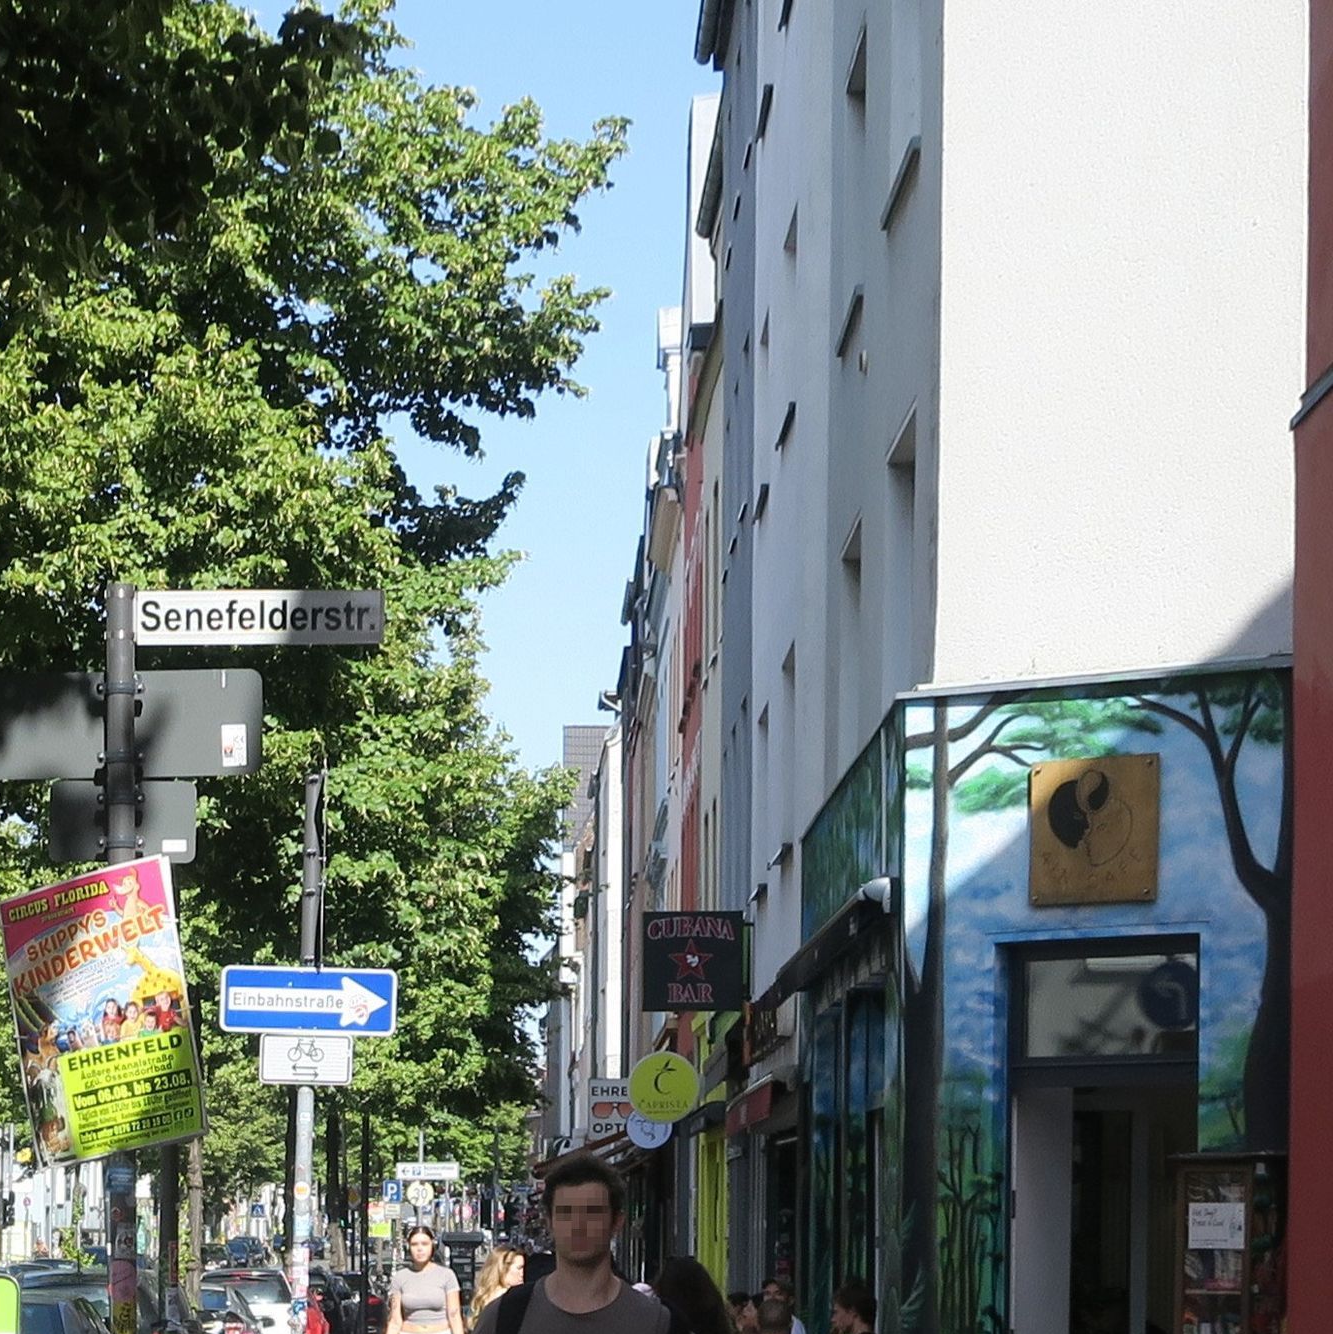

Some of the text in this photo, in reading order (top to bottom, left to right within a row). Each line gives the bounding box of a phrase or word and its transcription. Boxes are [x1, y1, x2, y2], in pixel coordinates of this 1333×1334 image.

[141, 600, 375, 632] Senefelderstr.
[8, 880, 110, 922] CIRCUS FLORIDA
[26, 910, 107, 962] SKIPPYS
[647, 916, 735, 941] CUBANA
[12, 905, 165, 996] KINDERWELT
[233, 992, 344, 1009] Einbahnstraße
[667, 983, 714, 1003] BAR
[68, 1034, 183, 1071] EHRENFELD
[114, 1053, 175, 1072] Kanalstraße
[105, 1062, 173, 1083] Ossendorfbad
[74, 1093, 97, 1109] Vom
[133, 1079, 152, 1096] bis
[154, 1073, 191, 1092] 23.08.
[591, 1086, 628, 1097] EHRE
[593, 1123, 627, 1134] OPT
